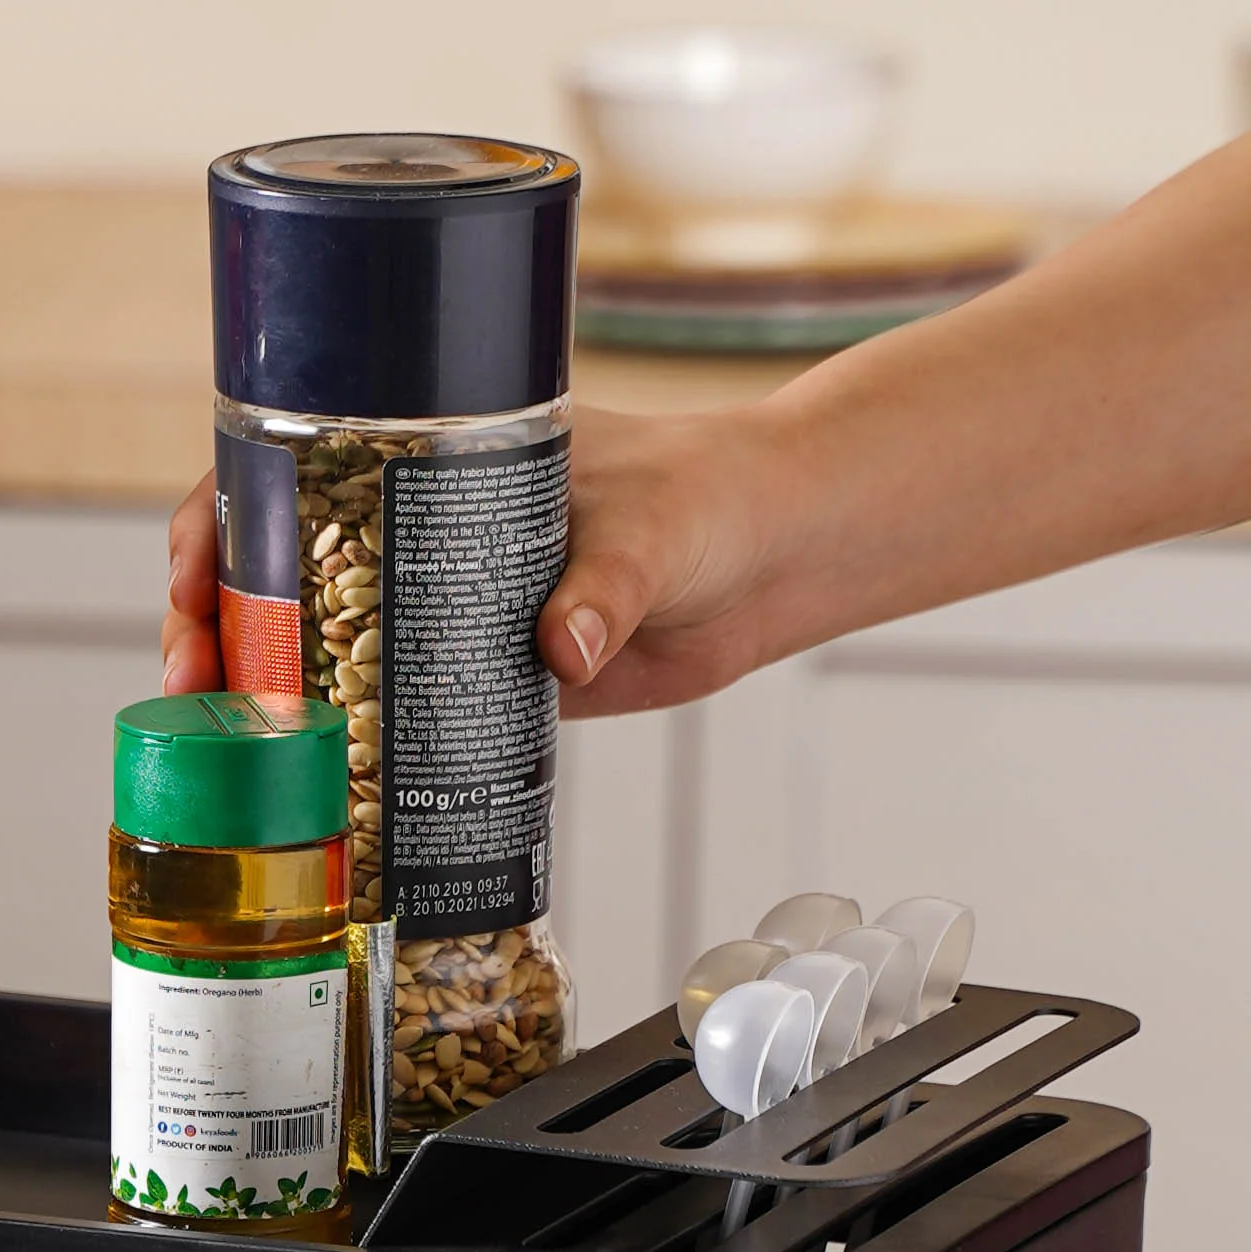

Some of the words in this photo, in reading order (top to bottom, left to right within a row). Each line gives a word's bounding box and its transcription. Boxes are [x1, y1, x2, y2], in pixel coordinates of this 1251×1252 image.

[481, 892, 515, 909] L9294
[158, 983, 200, 995] Ingredient:
[202, 988, 237, 998] Oregano
[238, 988, 262, 997] (Herb)
[334, 990, 342, 1006] only
[334, 1007, 342, 1038] purpose
[176, 1028, 183, 1037] of
[331, 1039, 340, 1092] representation
[170, 1091, 196, 1101] Weight
[158, 1105, 172, 1114] BEST
[173, 1106, 196, 1117] BEFORE
[198, 1109, 225, 1118] TWENTY
[226, 1111, 245, 1119] FOUR
[246, 1110, 273, 1118] MONTHS
[274, 1106, 293, 1117] FROM
[200, 1127, 238, 1137] keyafoods
[157, 1138, 193, 1150] PRODUCT
[195, 1143, 207, 1151] OF
[208, 1144, 233, 1152] INDIA
